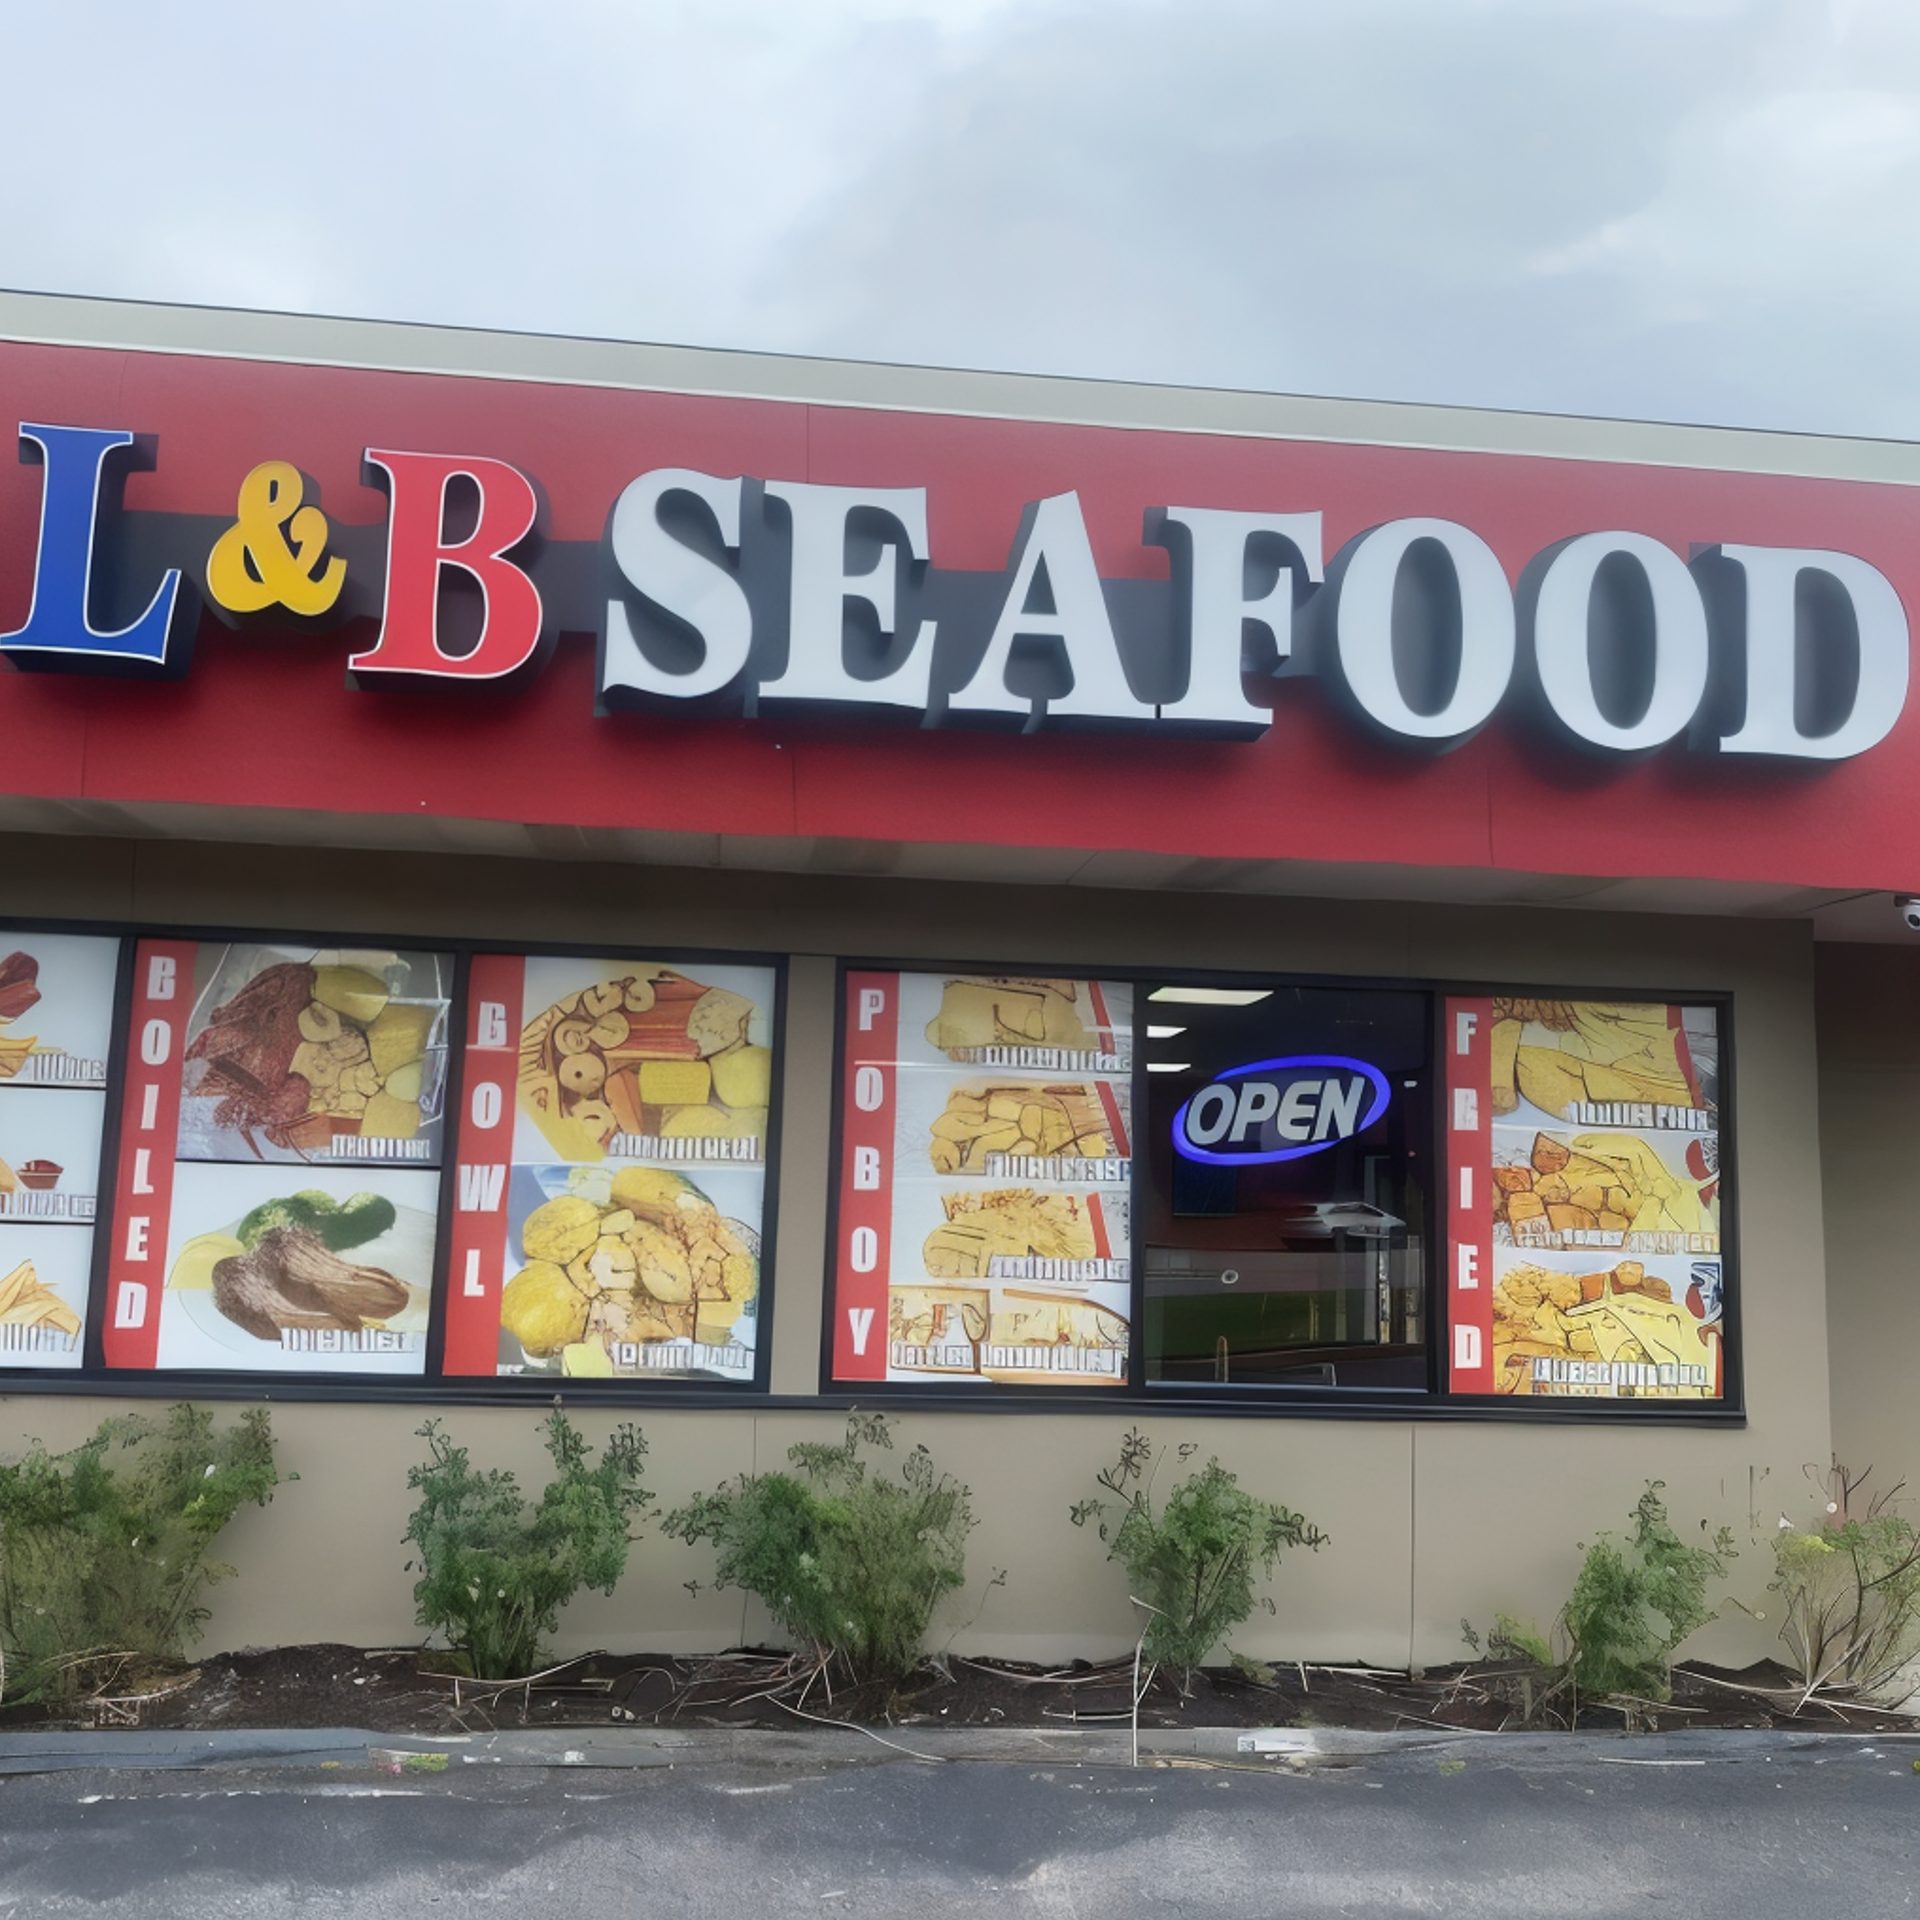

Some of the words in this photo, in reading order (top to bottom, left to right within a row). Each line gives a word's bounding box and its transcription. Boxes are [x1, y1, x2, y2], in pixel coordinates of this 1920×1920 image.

[0, 421, 182, 665] L
[206, 461, 347, 616] &
[348, 447, 543, 679] B
[601, 467, 1911, 761] SEAFOOD
[114, 955, 177, 1330] BOILED
[1185, 1076, 1365, 1146] OPEN
